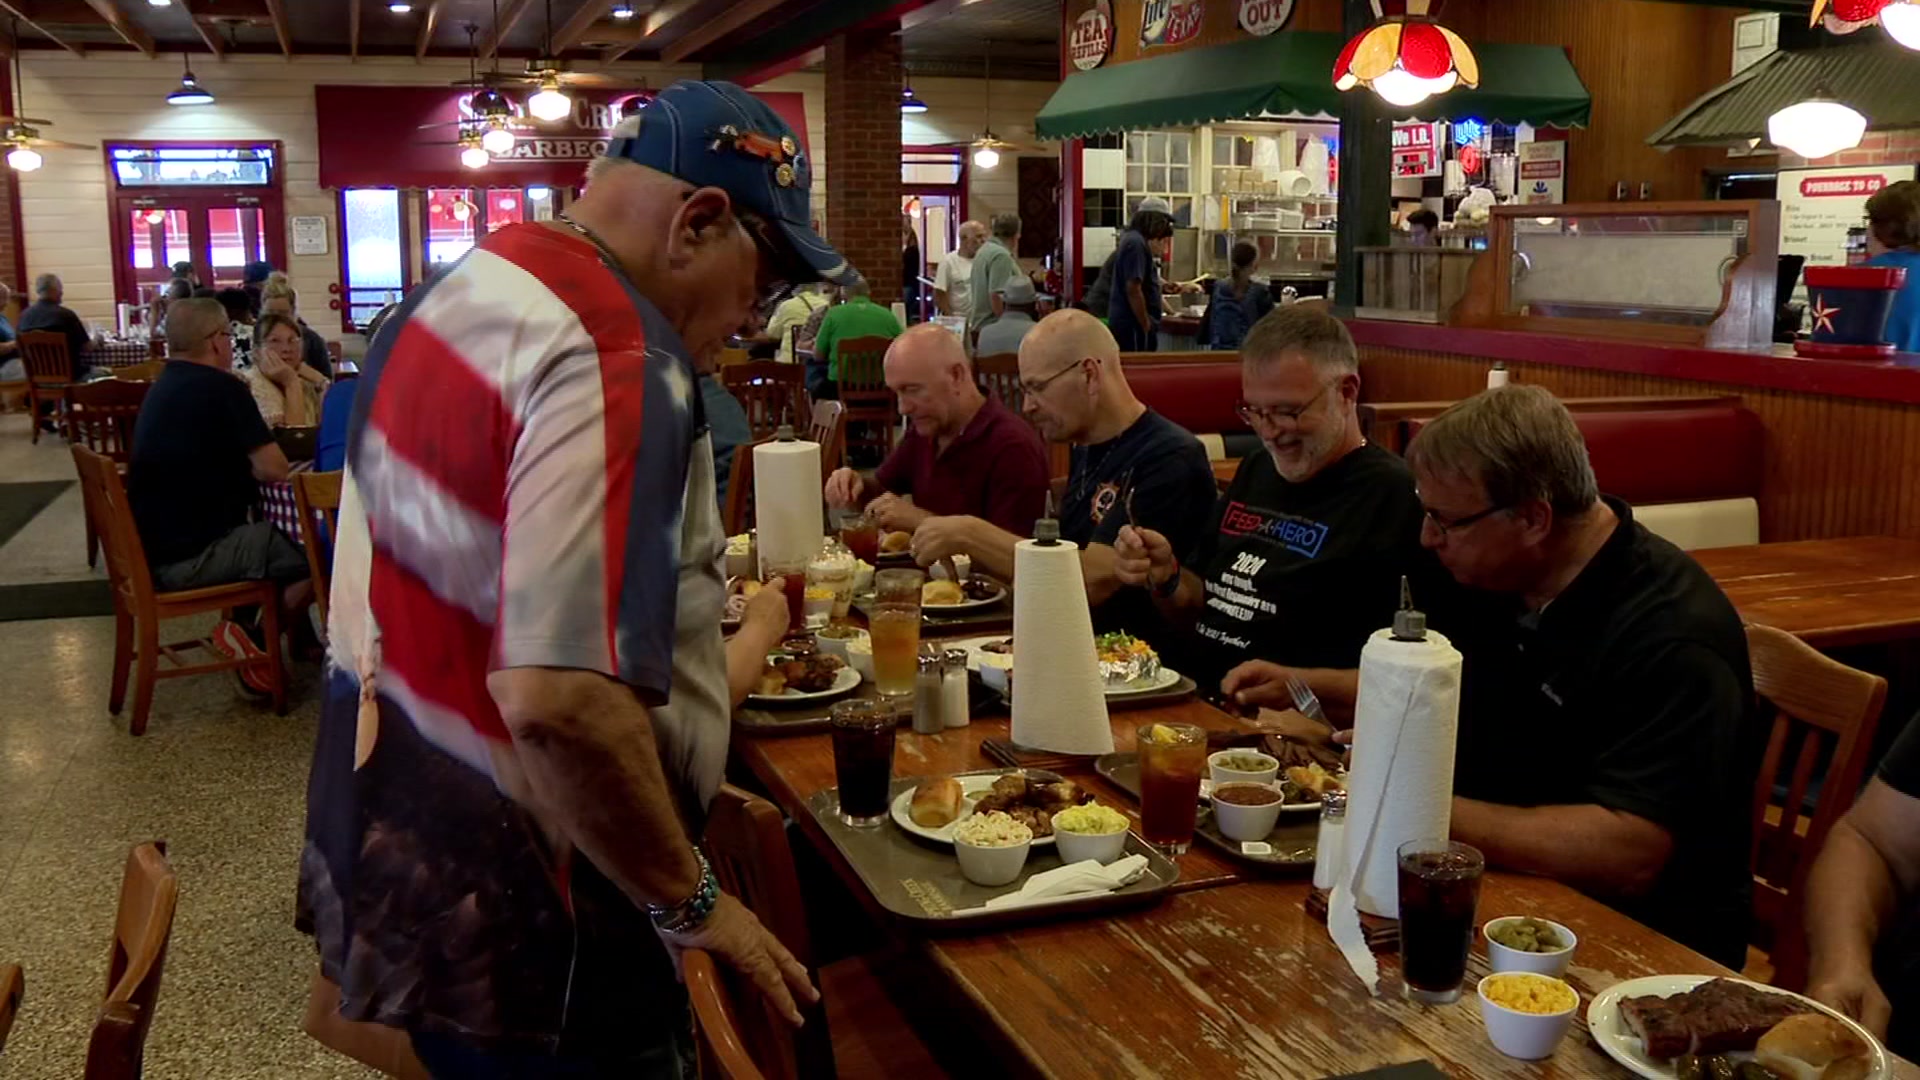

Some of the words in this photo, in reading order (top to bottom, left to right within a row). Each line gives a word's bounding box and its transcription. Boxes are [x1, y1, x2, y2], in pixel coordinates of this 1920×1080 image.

[1247, 2, 1282, 26] OUT
[1073, 20, 1104, 44] TEA
[1231, 551, 1267, 576] 2020
